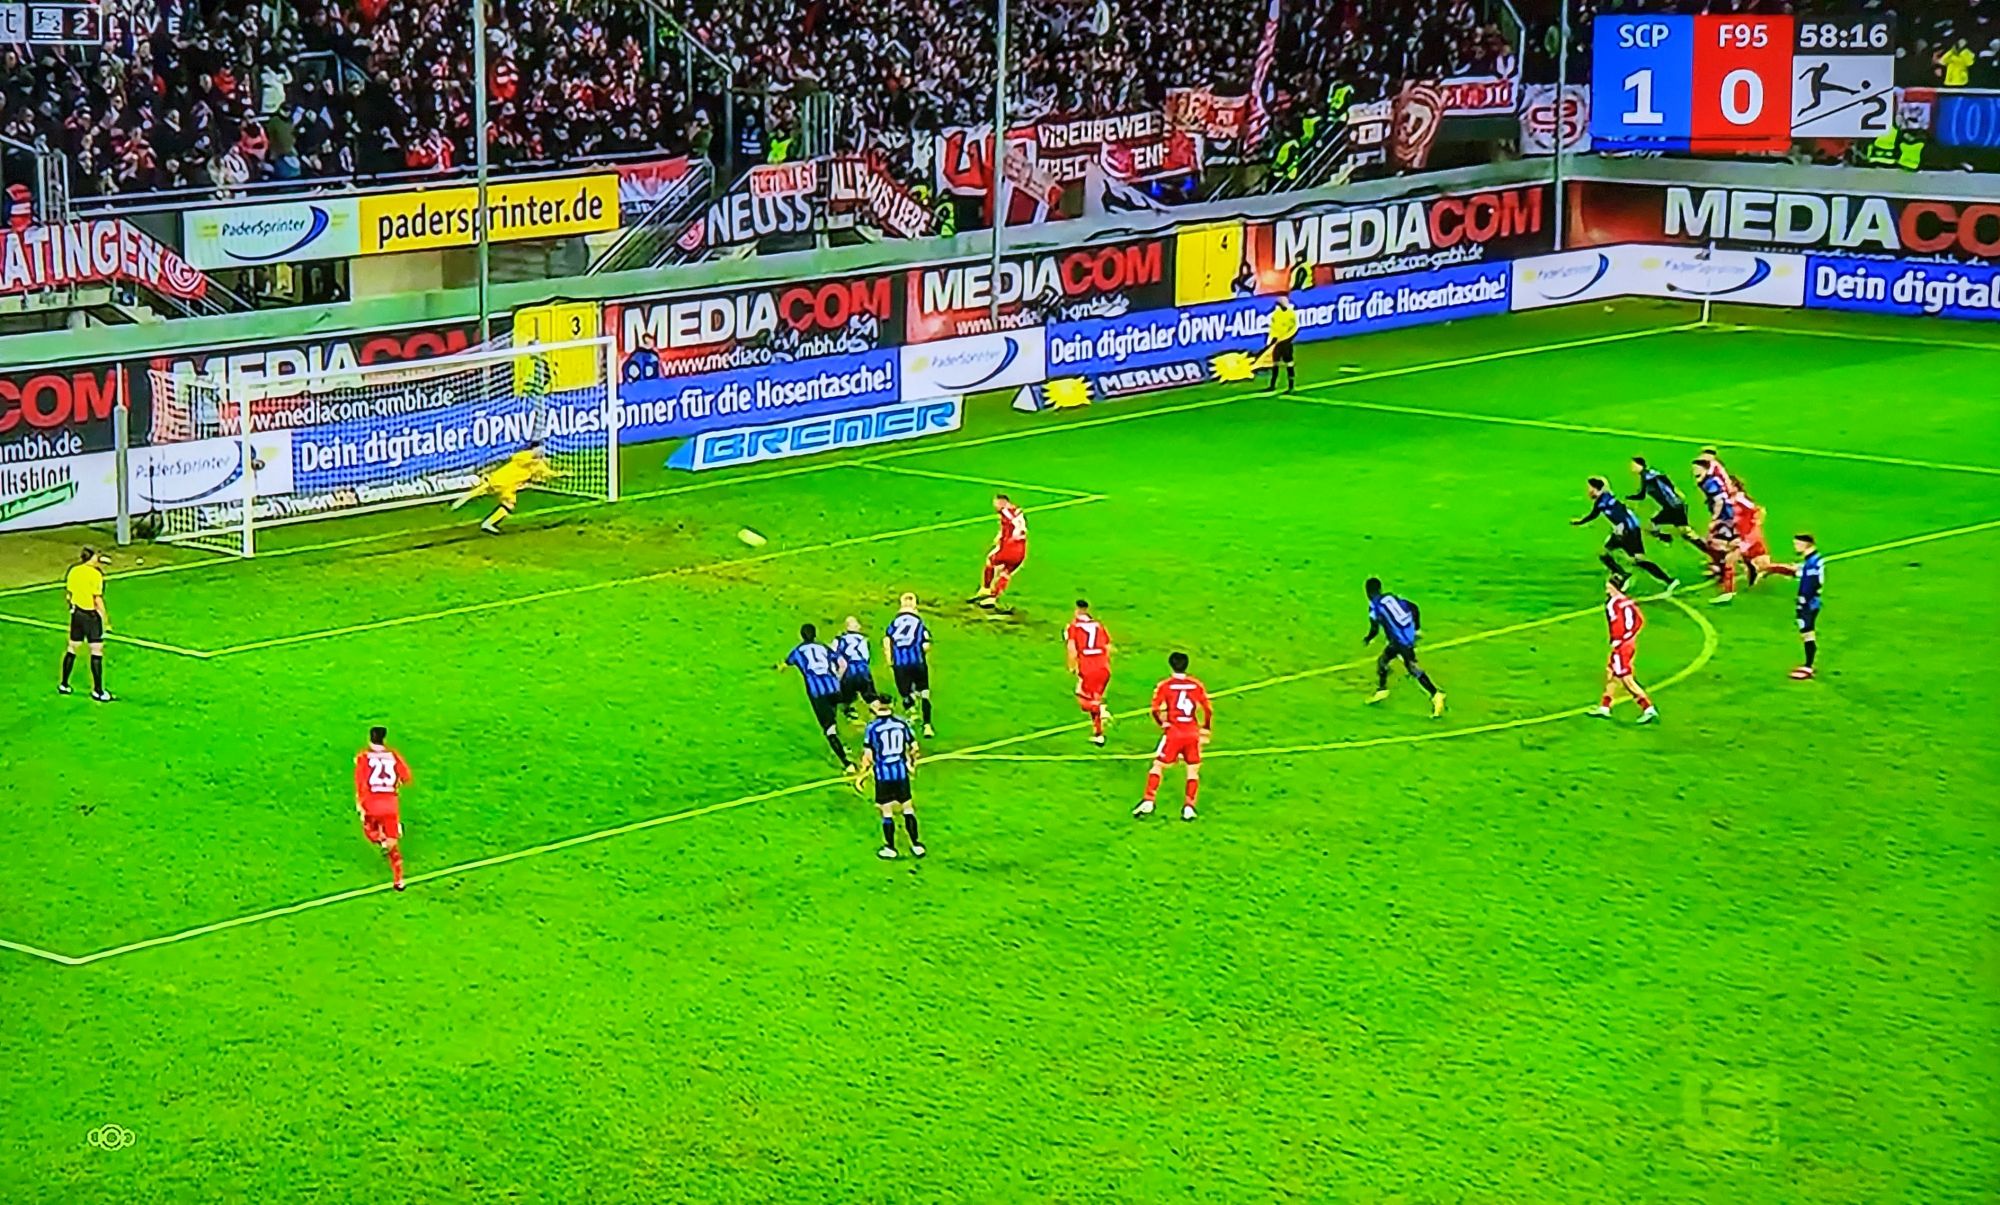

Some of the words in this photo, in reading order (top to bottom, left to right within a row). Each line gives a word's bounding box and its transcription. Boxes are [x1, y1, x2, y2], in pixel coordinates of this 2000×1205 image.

[221, 216, 306, 238] PaderSprinter
[378, 186, 603, 249] padersprinter.de
[707, 192, 813, 246] NEUSS
[1275, 187, 1542, 271] MEDIACOM
[1664, 186, 2000, 257] MEDIACO
[0, 218, 164, 289] ATINGEN
[1220, 234, 1230, 250] 4
[923, 242, 1163, 314] MEDIACOM
[1816, 265, 1886, 301] Dein
[571, 316, 581, 335] 3
[623, 276, 892, 352] MEDIACOM
[1050, 332, 1094, 365] Dein
[1096, 325, 1175, 360] digitaler
[1178, 304, 1335, 347] ÖPNV-Allenner
[1337, 294, 1364, 323] für
[1366, 291, 1393, 319] die
[1397, 273, 1506, 315] Hosentasche!
[1098, 362, 1202, 392] MERKUR
[301, 437, 358, 472] Dein
[363, 421, 469, 470] digitaler
[679, 387, 713, 420] für
[720, 383, 751, 415] die
[756, 361, 893, 409] Hosentasche!
[702, 401, 956, 464] BREMER
[0, 428, 82, 464] mbh.de
[1078, 624, 1098, 649] 7
[1176, 690, 1195, 716] 4
[879, 729, 905, 756] 10
[367, 757, 398, 787] 23
